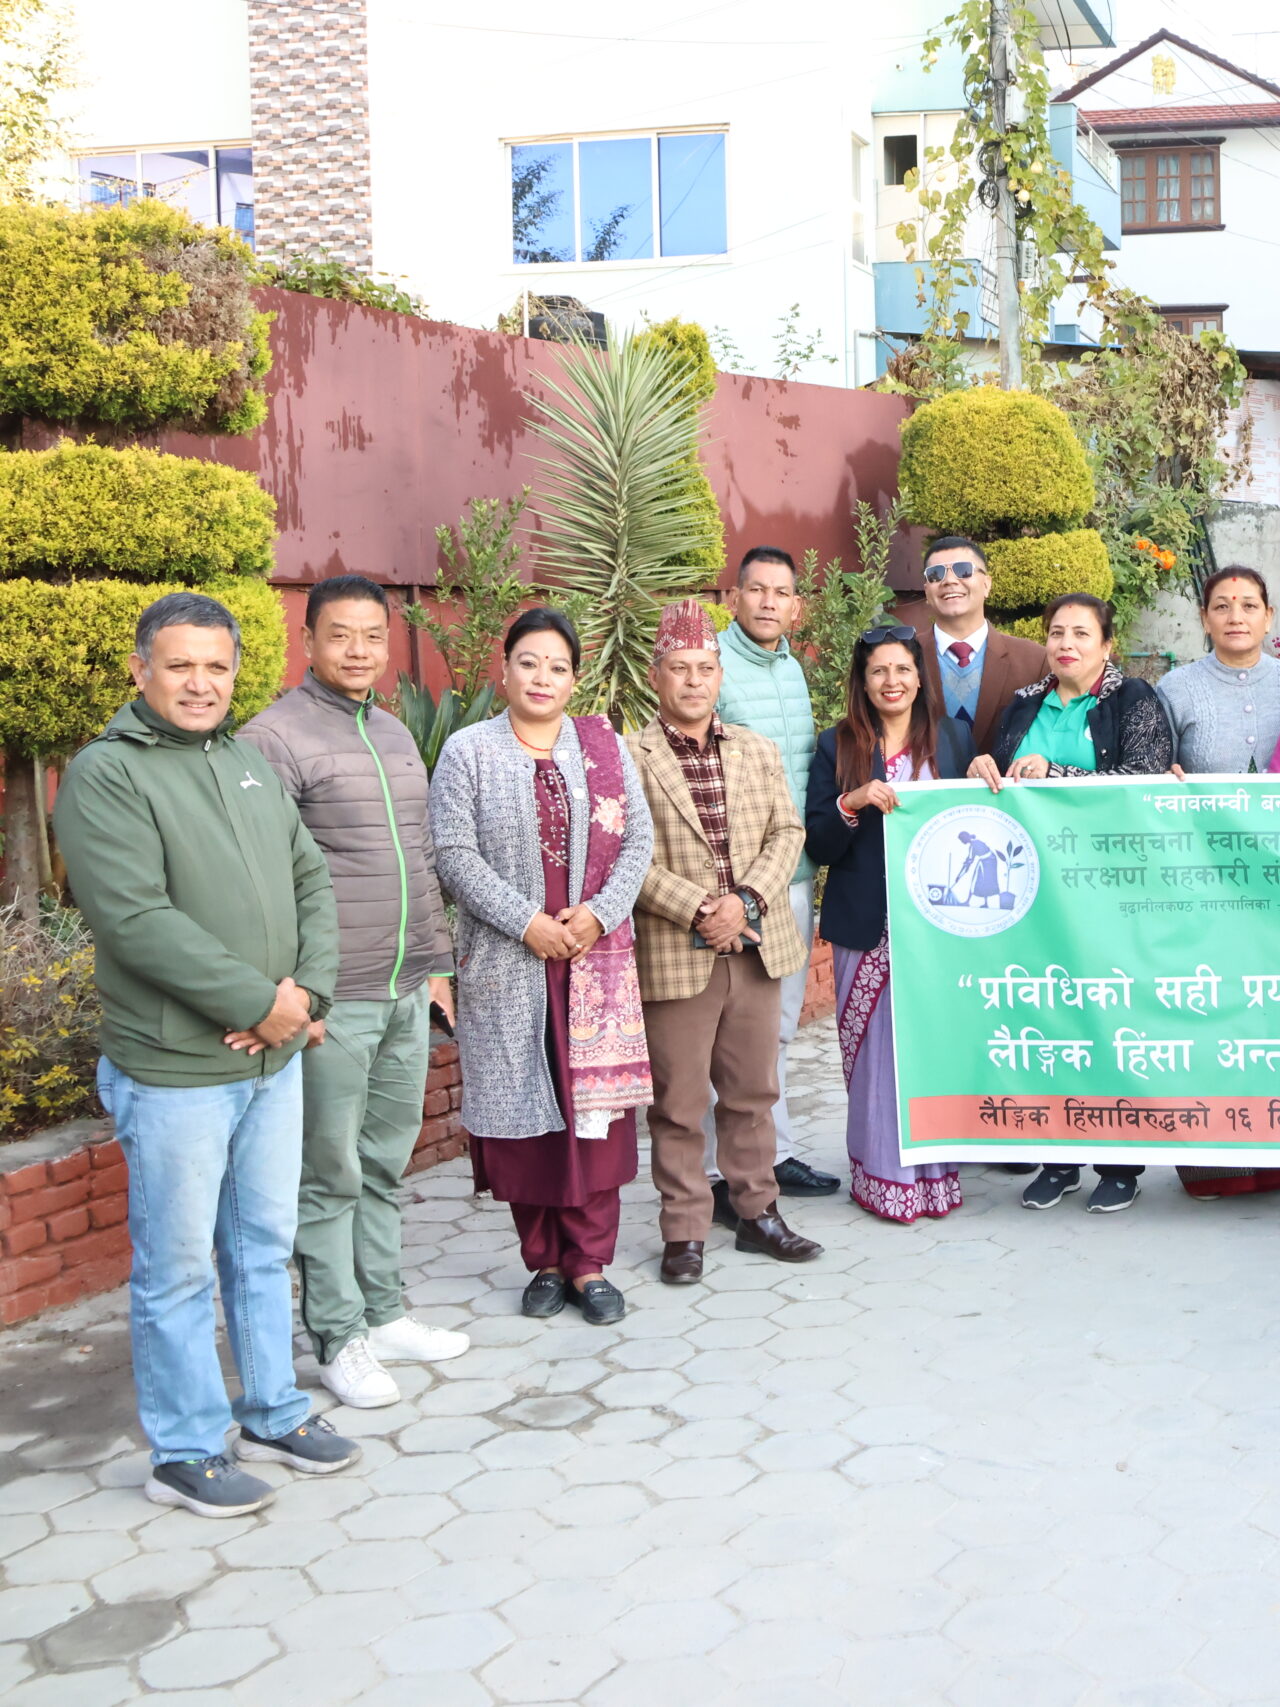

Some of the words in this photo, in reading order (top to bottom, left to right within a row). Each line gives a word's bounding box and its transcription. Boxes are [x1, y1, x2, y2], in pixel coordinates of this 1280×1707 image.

[1046, 826, 1078, 854] श्री
[1090, 832, 1194, 863] जनसुचना
[1061, 862, 1147, 890] संरक्षण
[1160, 857, 1250, 891] सहकारी
[1200, 895, 1271, 913] नगरपालिका
[1154, 964, 1222, 1016] सही
[987, 1024, 1093, 1078] लैङ्गिक
[1112, 1027, 1194, 1080] हिंसा
[979, 1096, 1050, 1131] लैङ्गिक
[1063, 1098, 1210, 1132] हिंसाविरुद्धको
[1225, 1107, 1252, 1132] १६
